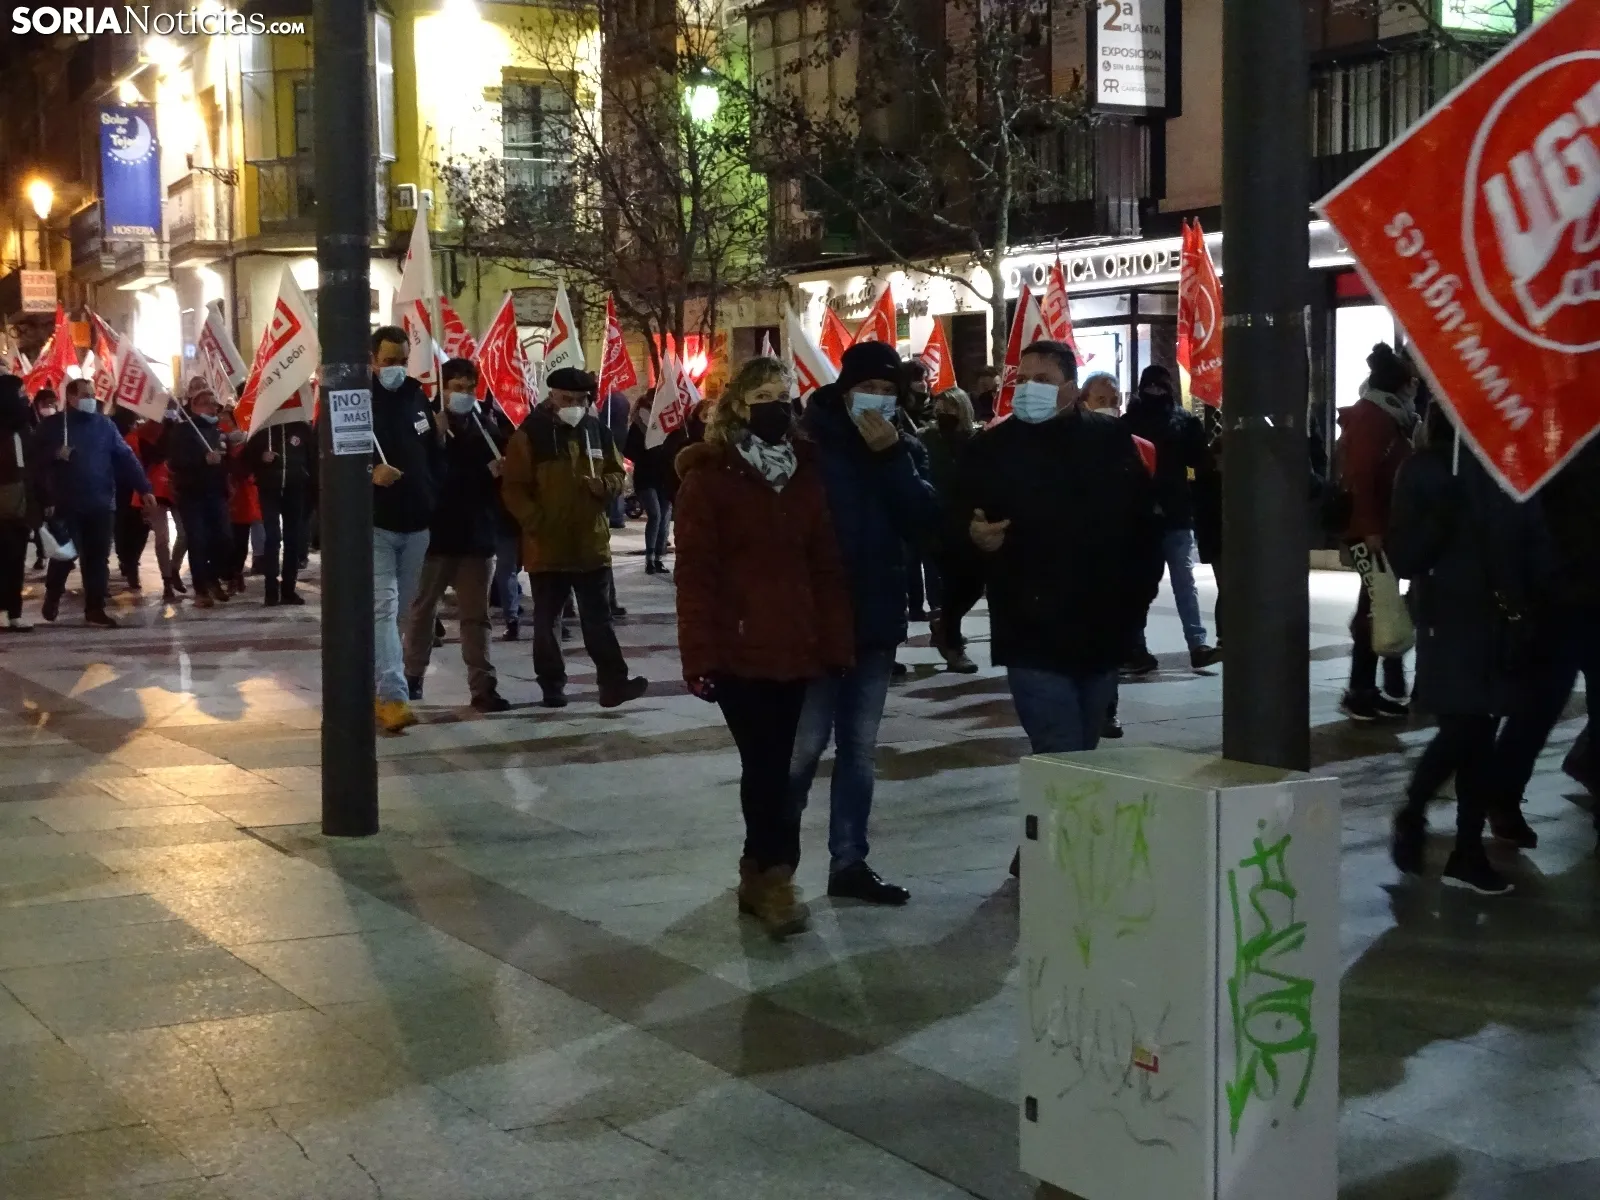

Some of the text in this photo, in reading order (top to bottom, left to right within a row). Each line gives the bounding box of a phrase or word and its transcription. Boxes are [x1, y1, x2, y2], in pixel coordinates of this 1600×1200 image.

[1123, 23, 1161, 35] PLANTA
[1103, 249, 1181, 279] ORTOPE
[1384, 211, 1533, 431] www.ugt.es
[273, 368, 281, 380] y
[279, 342, 306, 370] León
[545, 350, 569, 373] León
[344, 410, 371, 424] MÁS!
